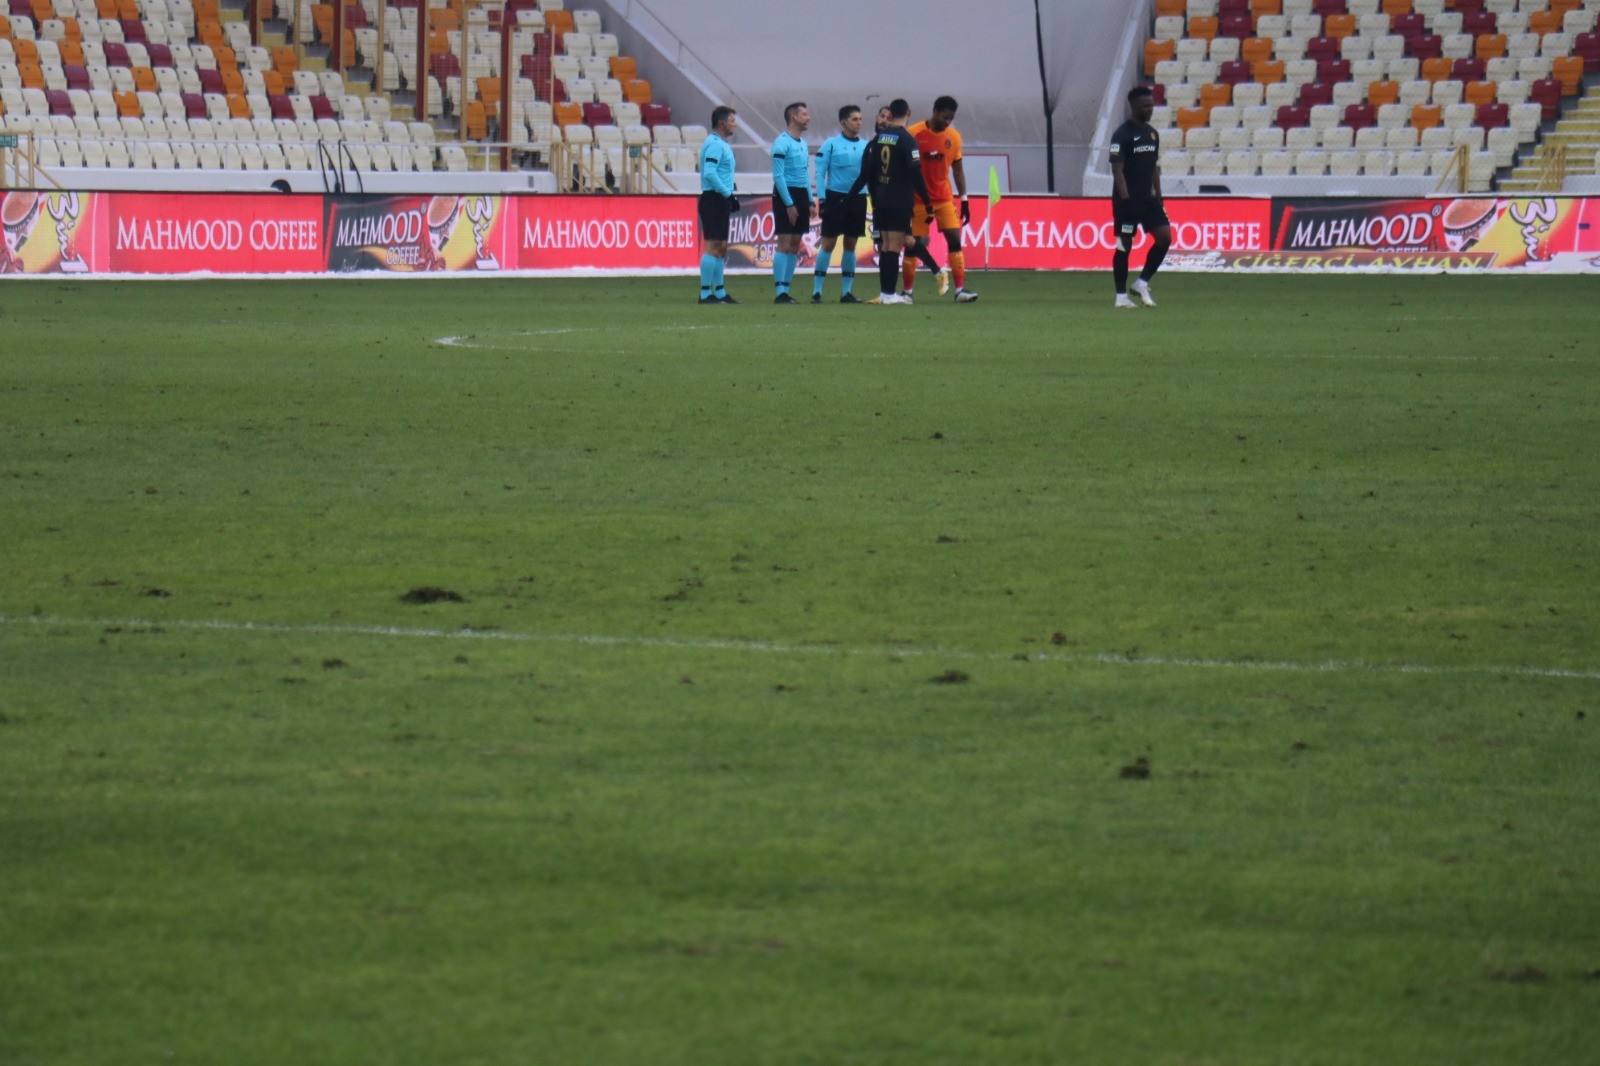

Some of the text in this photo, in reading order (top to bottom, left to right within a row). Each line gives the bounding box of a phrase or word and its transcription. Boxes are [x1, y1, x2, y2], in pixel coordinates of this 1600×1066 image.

[881, 145, 891, 175] 9
[116, 216, 318, 250] MAHMOOD COFFEE
[336, 210, 422, 247] MAHMOOD
[523, 216, 693, 249] MAHMOOD COFFEE
[1291, 212, 1433, 247] MAHMOOD
[386, 246, 420, 265] COFFEE
